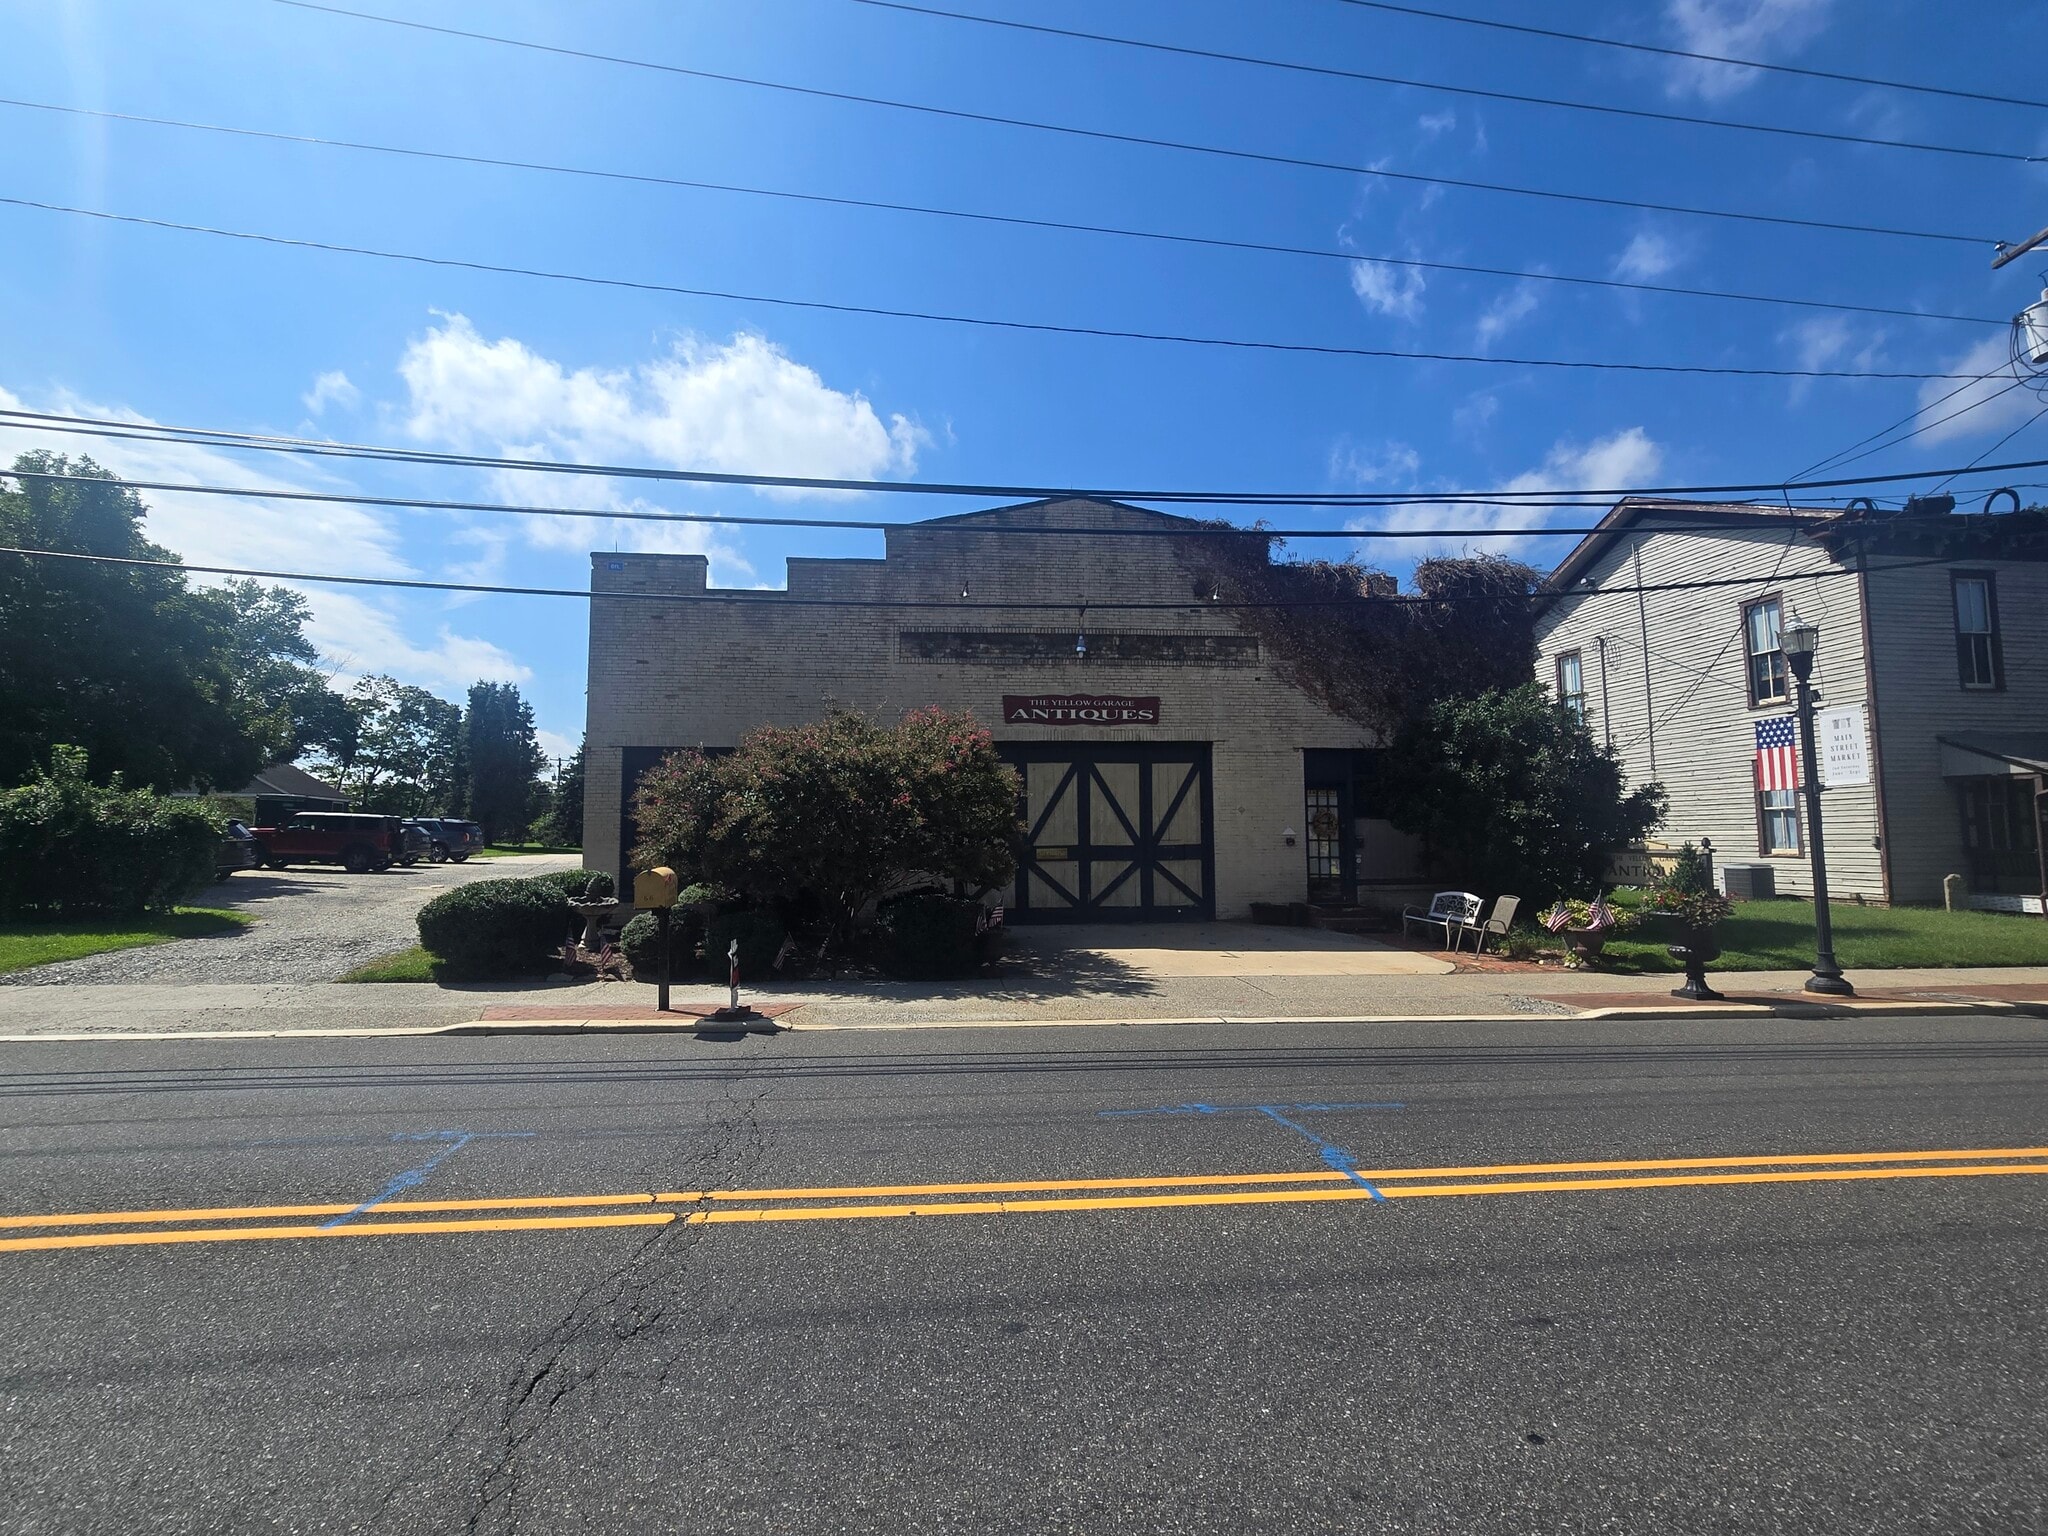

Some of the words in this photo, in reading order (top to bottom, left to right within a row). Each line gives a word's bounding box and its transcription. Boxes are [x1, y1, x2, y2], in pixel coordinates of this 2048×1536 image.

[1011, 709, 1153, 721] ANTIQUES
[1830, 743, 1858, 752] STREET
[1830, 753, 1860, 761] MARKET
